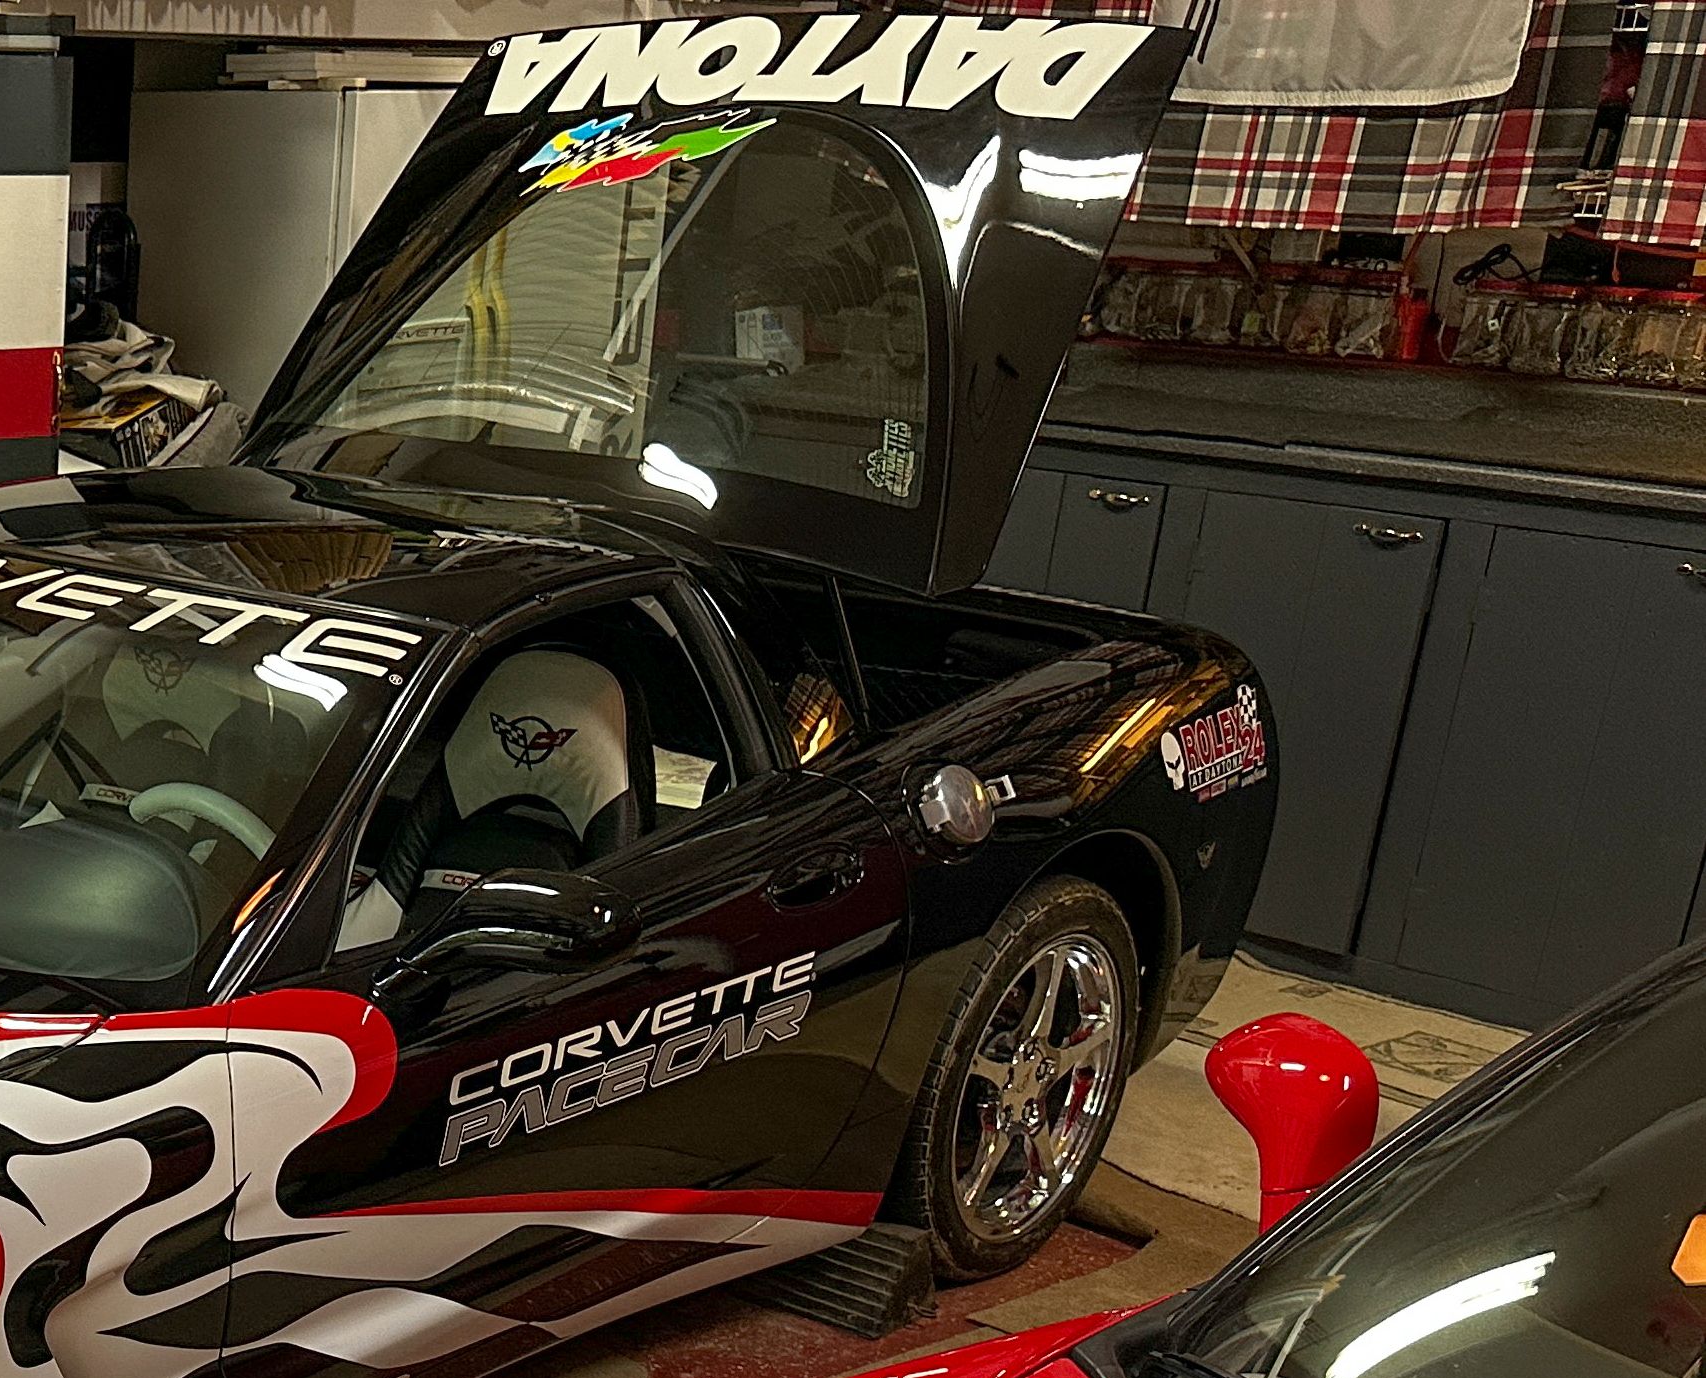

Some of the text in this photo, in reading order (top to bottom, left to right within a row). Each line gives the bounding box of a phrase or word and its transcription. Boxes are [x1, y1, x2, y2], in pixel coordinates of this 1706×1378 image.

[484, 15, 1156, 119] DAYTONA
[1179, 704, 1265, 773] ROLEX 24
[449, 951, 816, 1105] CORVETTE
